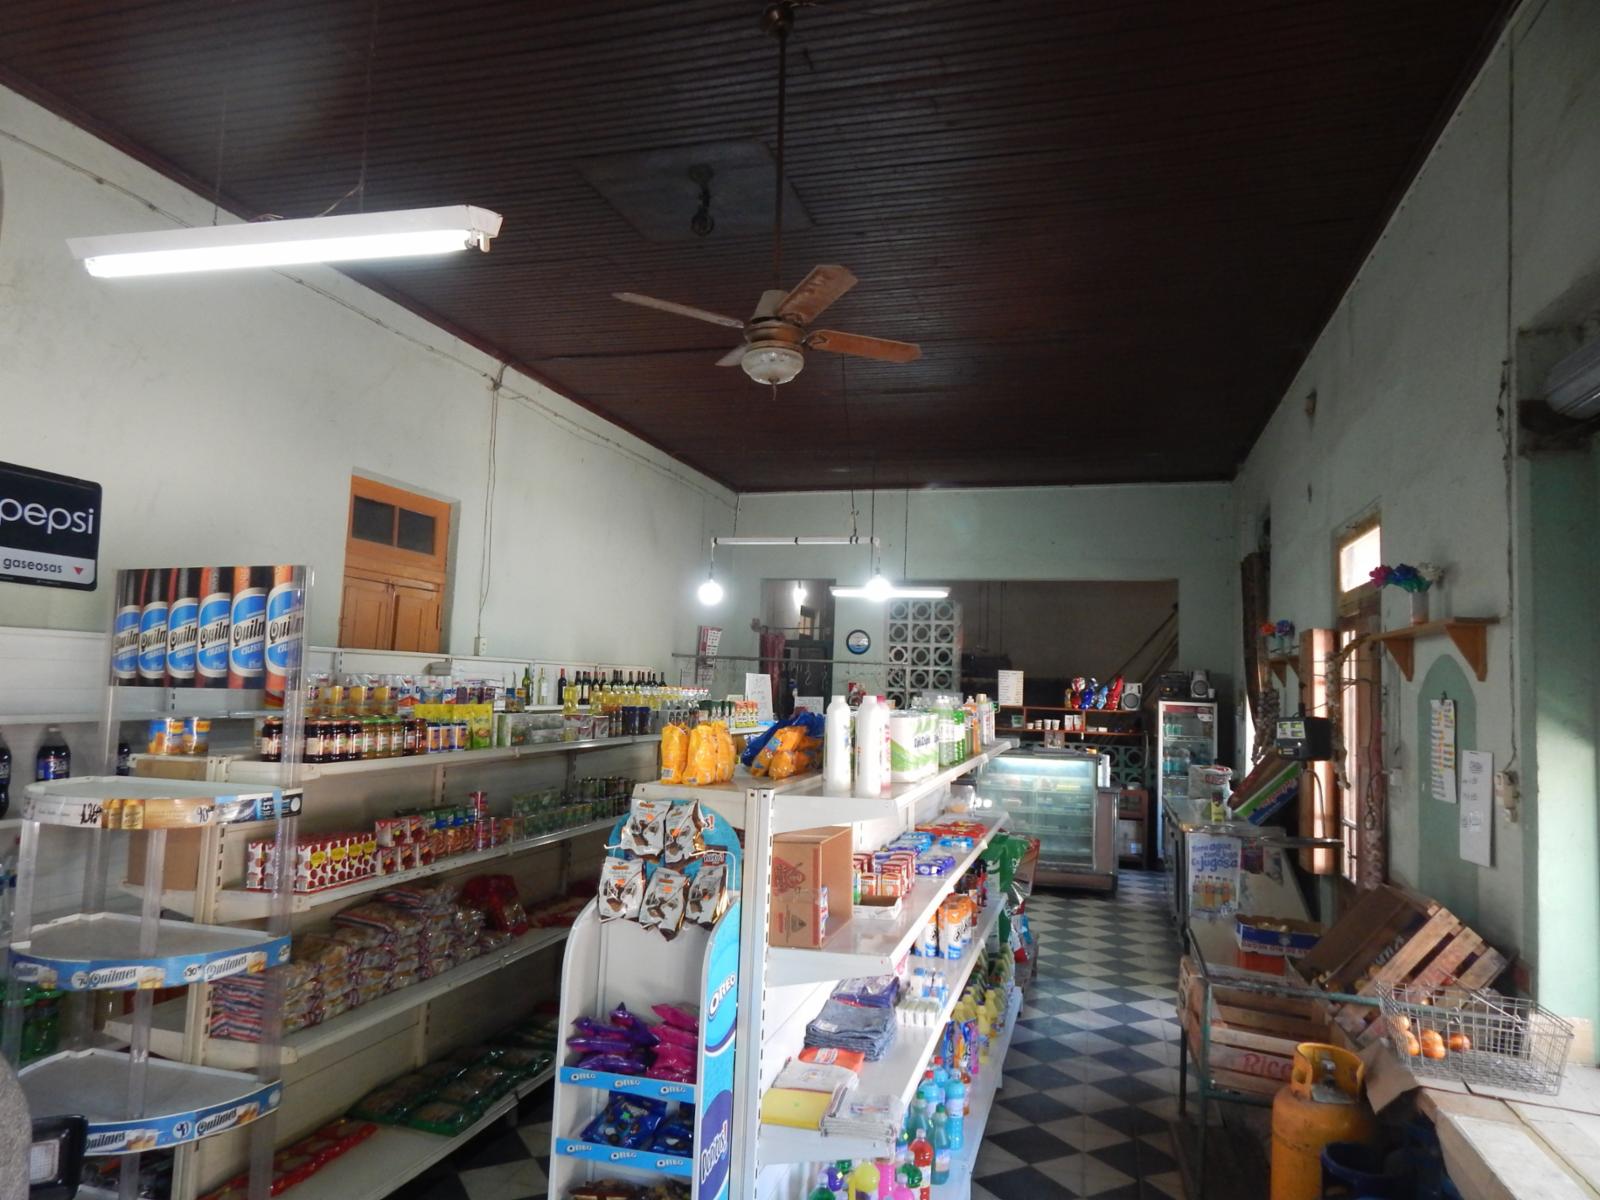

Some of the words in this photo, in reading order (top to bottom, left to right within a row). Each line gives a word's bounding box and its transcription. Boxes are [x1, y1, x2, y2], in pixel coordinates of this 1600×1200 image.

[0, 498, 94, 535] pepsi
[3, 558, 63, 573] gaseosas
[206, 955, 248, 979] Quilmes
[90, 967, 137, 989] Quilmes
[708, 973, 736, 1021] OREO
[571, 1072, 597, 1081] OREO
[615, 1079, 641, 1088] OREO
[660, 1086, 686, 1095] OREO
[197, 1108, 238, 1136] Quilmes
[567, 1144, 592, 1153] OREO
[611, 1151, 637, 1160] OREO
[656, 1159, 683, 1168] OREO
